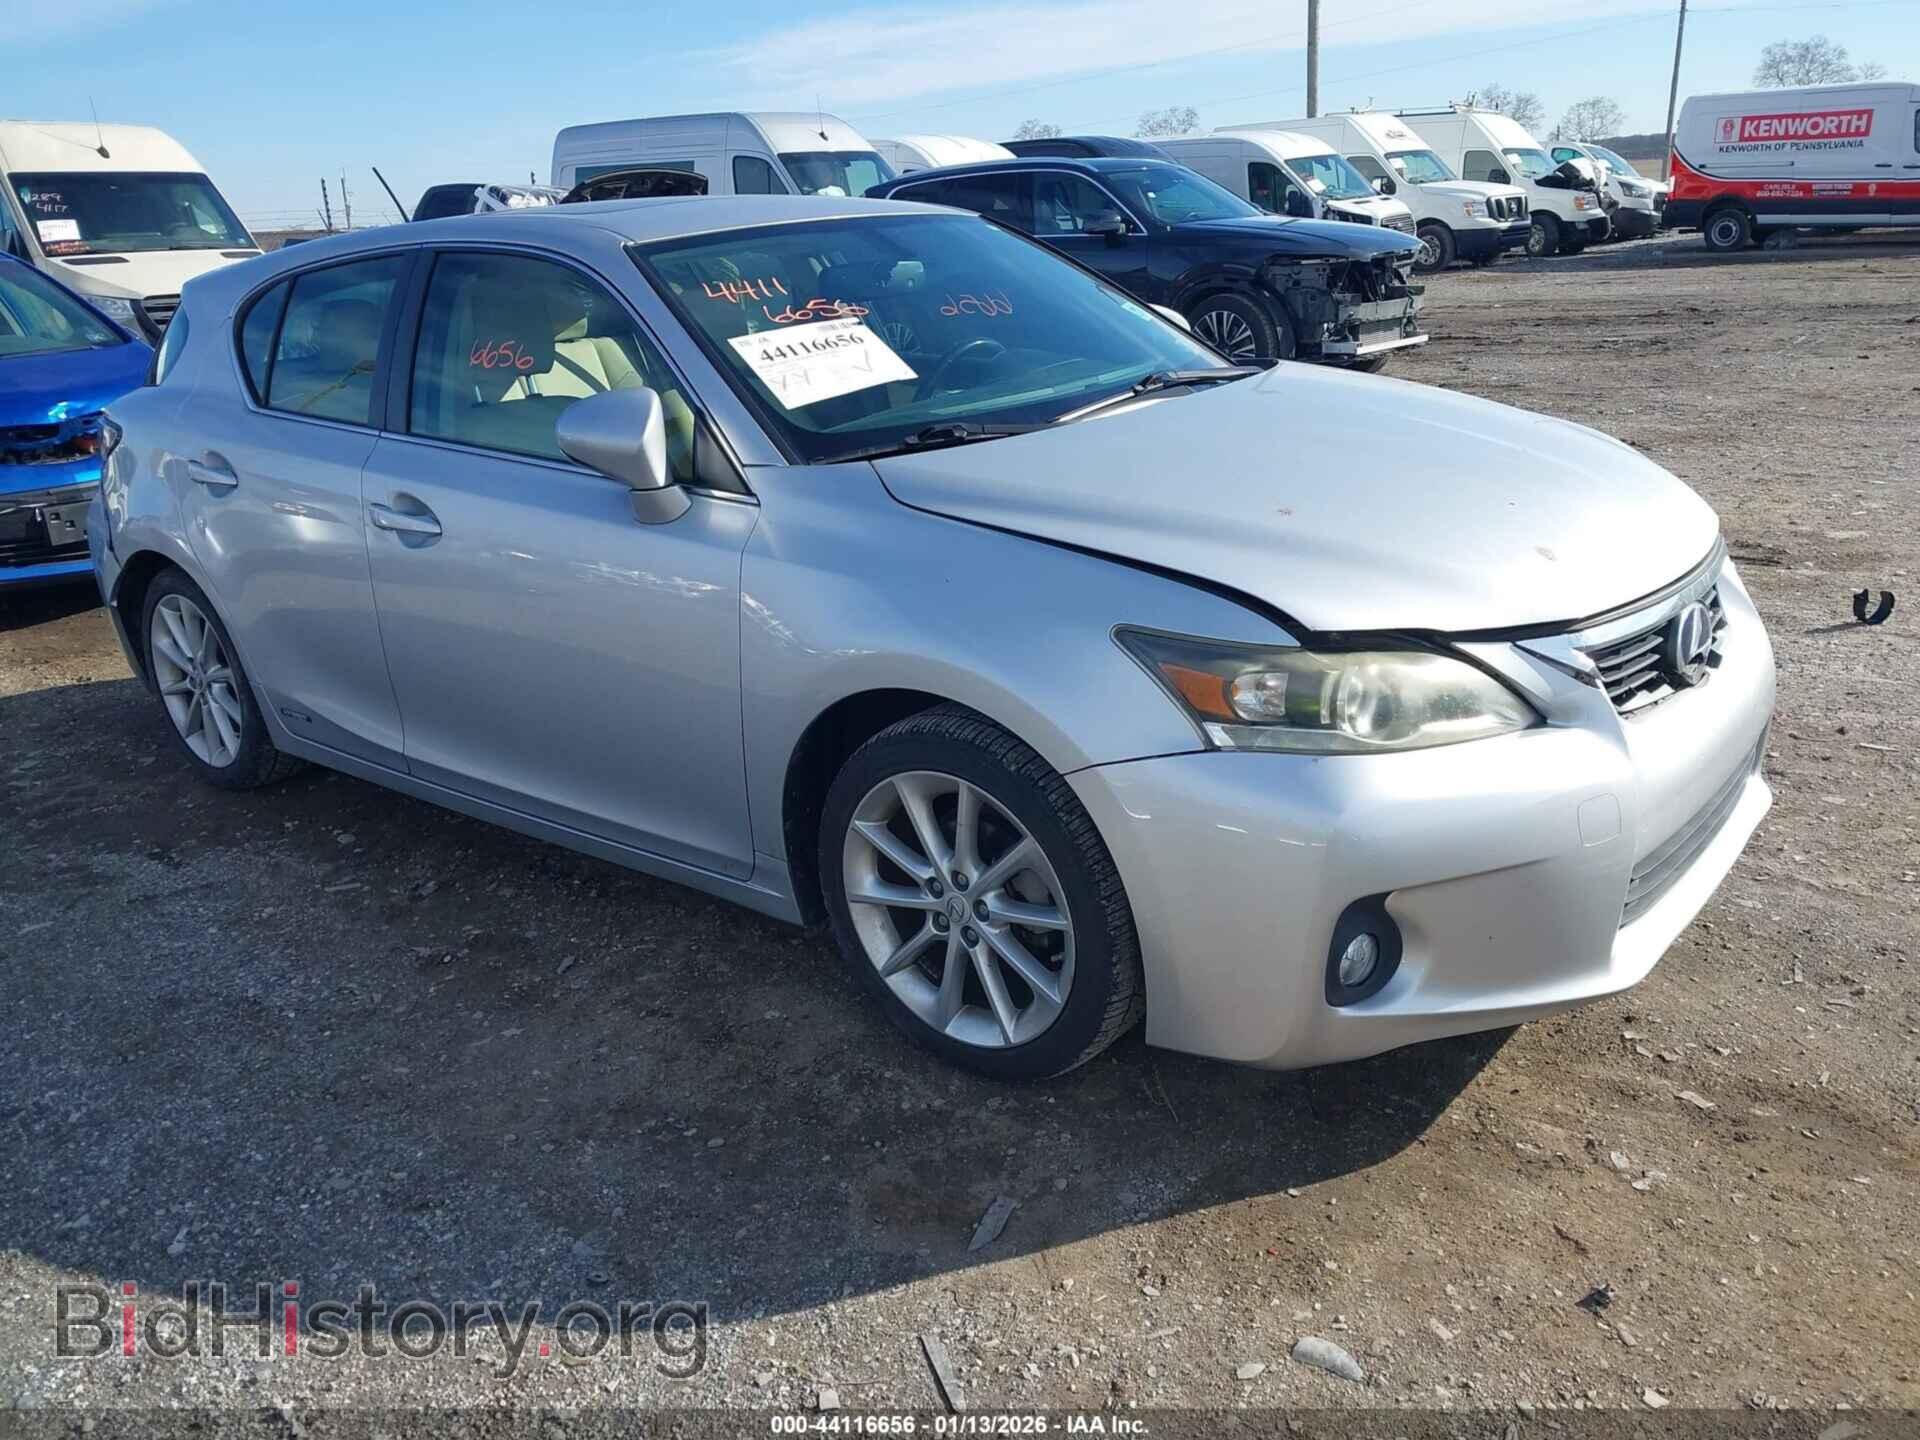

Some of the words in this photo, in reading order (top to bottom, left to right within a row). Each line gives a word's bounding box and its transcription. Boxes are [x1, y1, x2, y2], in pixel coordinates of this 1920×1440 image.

[1743, 113, 1868, 137] KENWORTH
[1718, 142, 1772, 153] KENWORTH
[1774, 142, 1787, 150] OF
[1790, 139, 1865, 150] PENNSYLVANIA
[702, 277, 788, 303] 4411
[470, 335, 534, 369] 6656
[760, 332, 864, 362] 44116656
